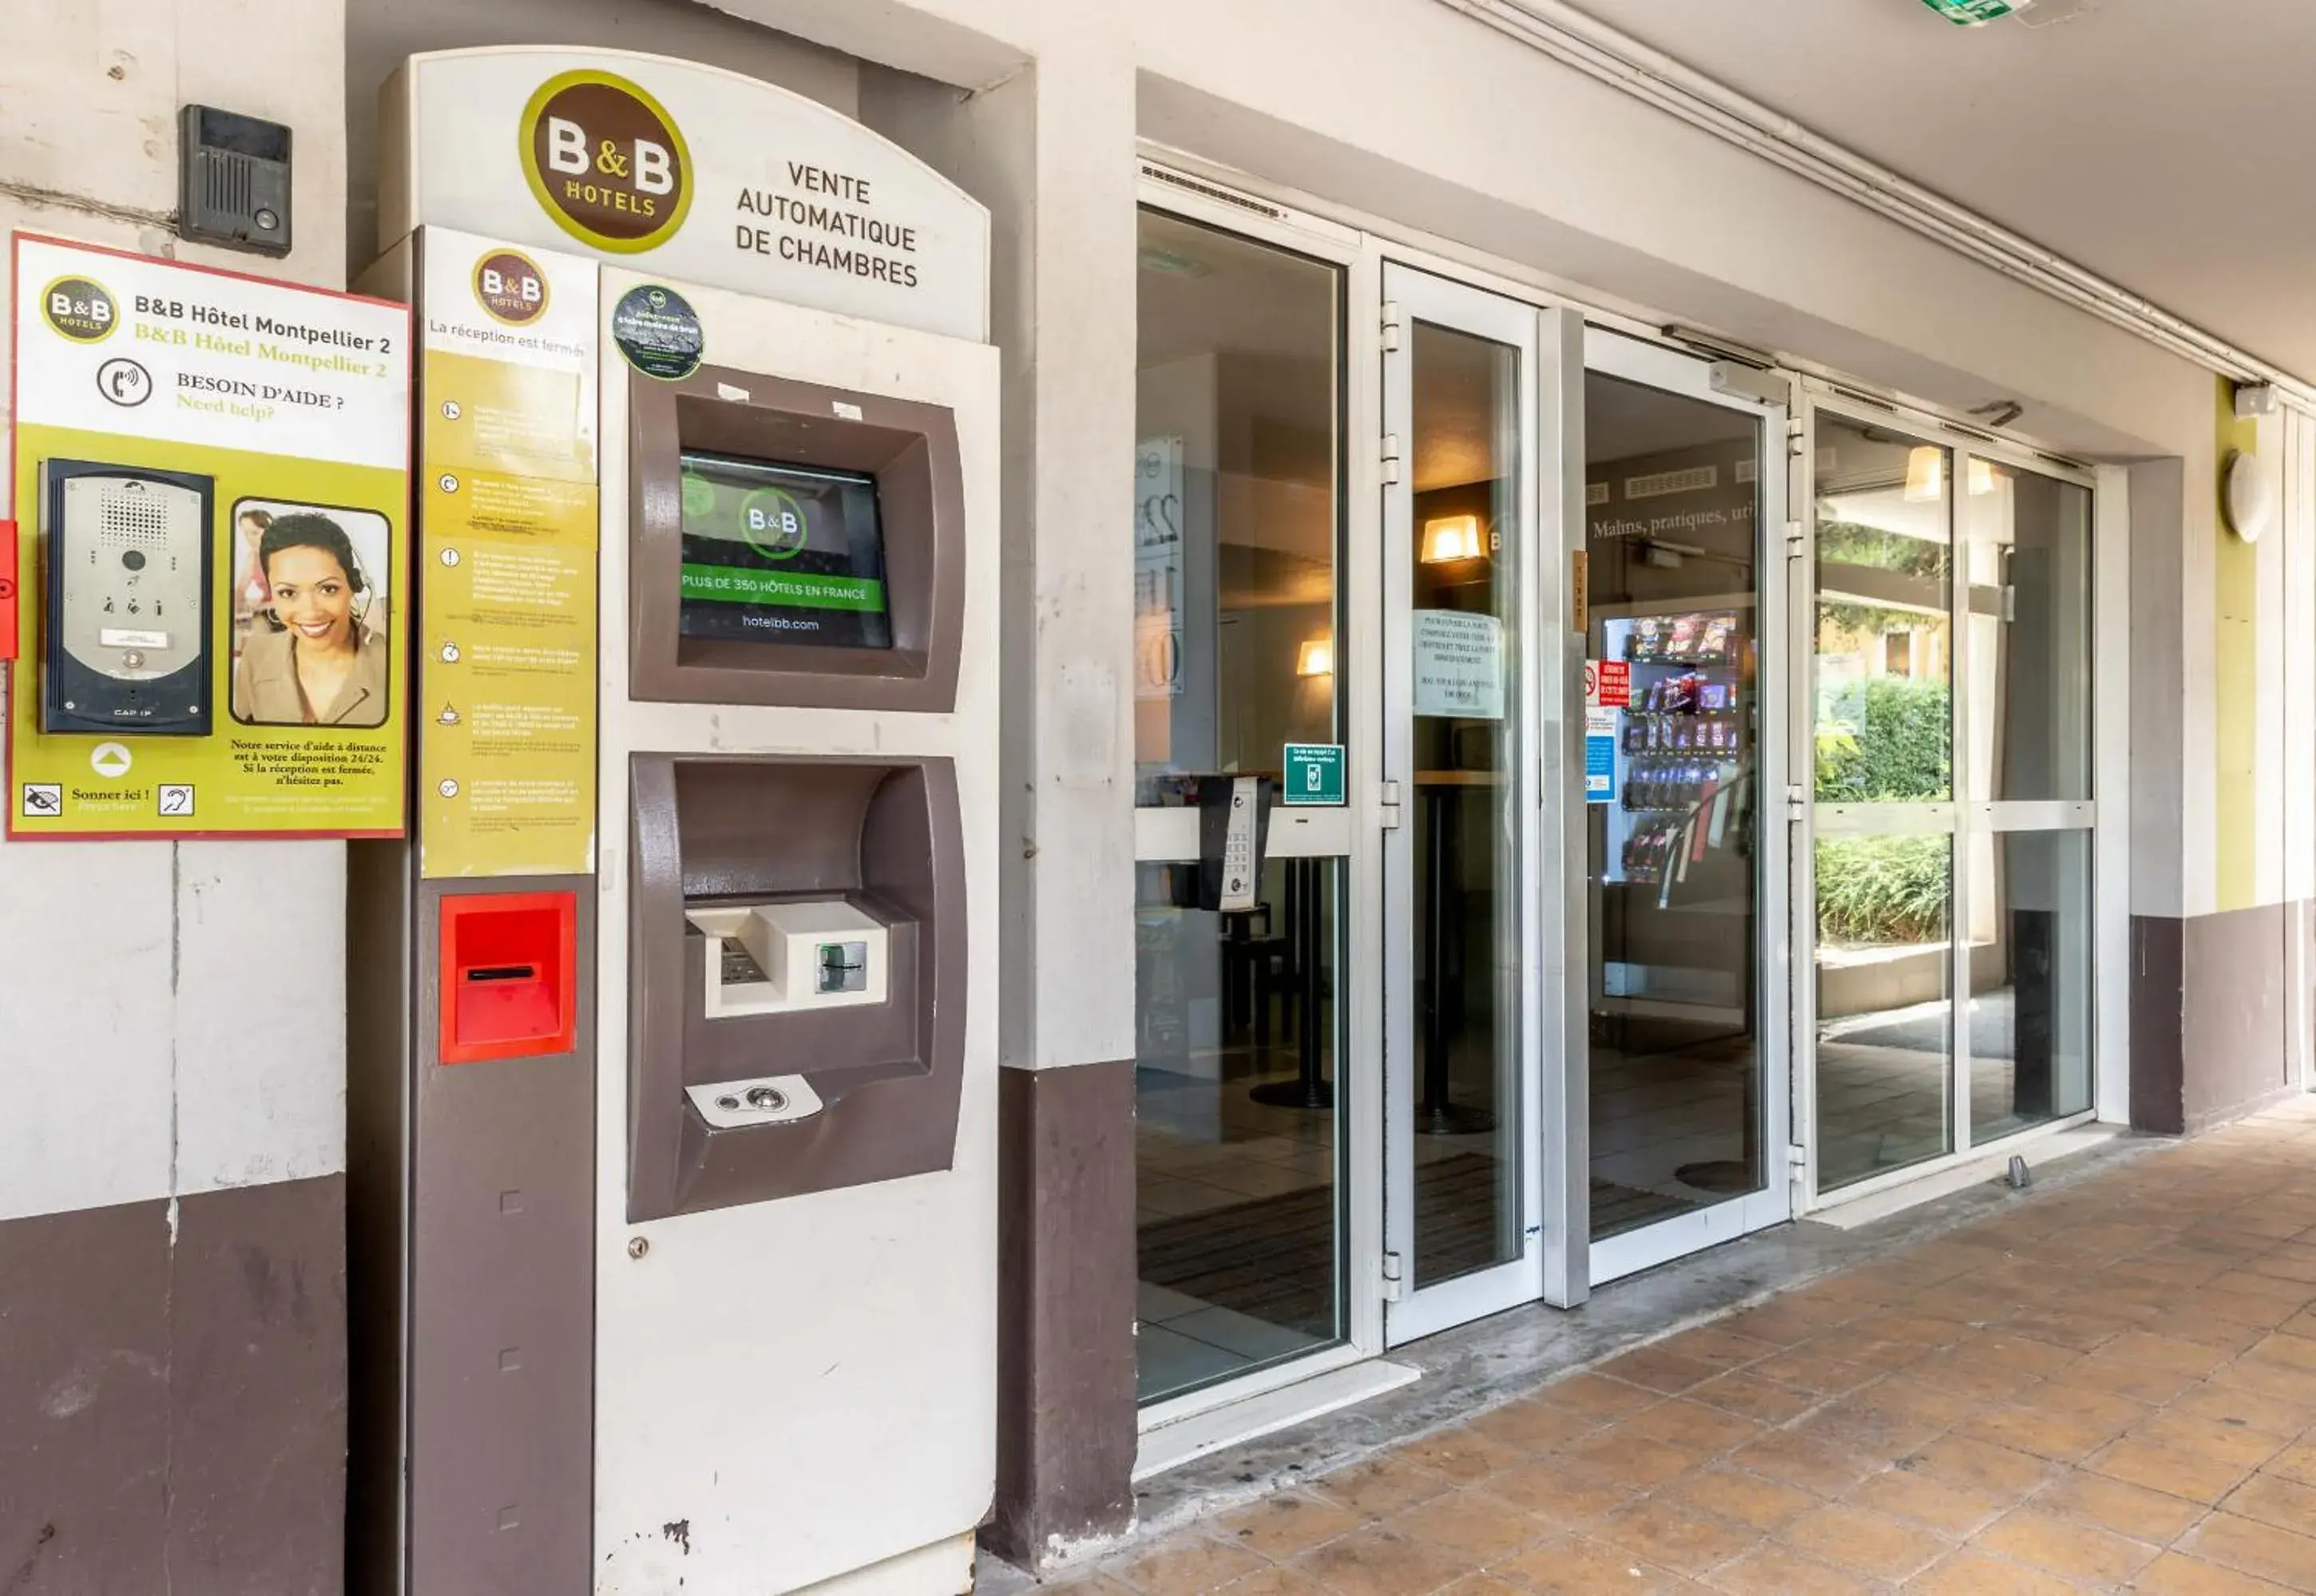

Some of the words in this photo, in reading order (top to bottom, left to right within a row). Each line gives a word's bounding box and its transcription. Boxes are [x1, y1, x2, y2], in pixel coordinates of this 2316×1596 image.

[787, 160, 870, 205] VENTE
[565, 180, 656, 218] HOTELS
[736, 188, 916, 252] AUTOMATIQUE
[736, 224, 771, 255] DE
[779, 232, 918, 288] CHAMBRES
[490, 295, 533, 311] HOTELS
[59, 317, 103, 330] HOTELS
[135, 295, 184, 319] B&B
[191, 304, 248, 331] Hôtel
[255, 316, 374, 351] Montpellier
[379, 338, 391, 354] 2
[430, 319, 447, 334] La
[451, 323, 515, 343] réception
[518, 337, 539, 349] est
[134, 323, 187, 345] B&B
[194, 331, 251, 356] Hôtel
[258, 343, 371, 376] Montpellier
[375, 362, 387, 378] 2
[176, 372, 256, 398] BESOIN
[263, 386, 331, 408] D'AIDE
[176, 393, 224, 414] Need
[229, 397, 275, 422] help?
[1650, 508, 1727, 536] pratiques,
[681, 575, 712, 588] PLUS
[716, 577, 730, 589] DE
[734, 578, 757, 592] 350
[759, 578, 803, 596] HÔTELS
[806, 585, 820, 596] EN
[823, 586, 866, 600] FRANCE
[743, 615, 819, 631] hotelbb.com
[230, 739, 262, 750] Notre
[265, 741, 300, 751] service
[303, 740, 335, 751] d'aide
[346, 742, 387, 753] distance
[291, 753, 348, 764] disposition
[243, 762, 254, 773] Si
[257, 763, 267, 773] la
[269, 763, 319, 777] réception
[276, 775, 321, 786] n'hésitez
[323, 778, 344, 787] pas.
[72, 787, 121, 800] Sonner
[124, 789, 141, 800] ici
